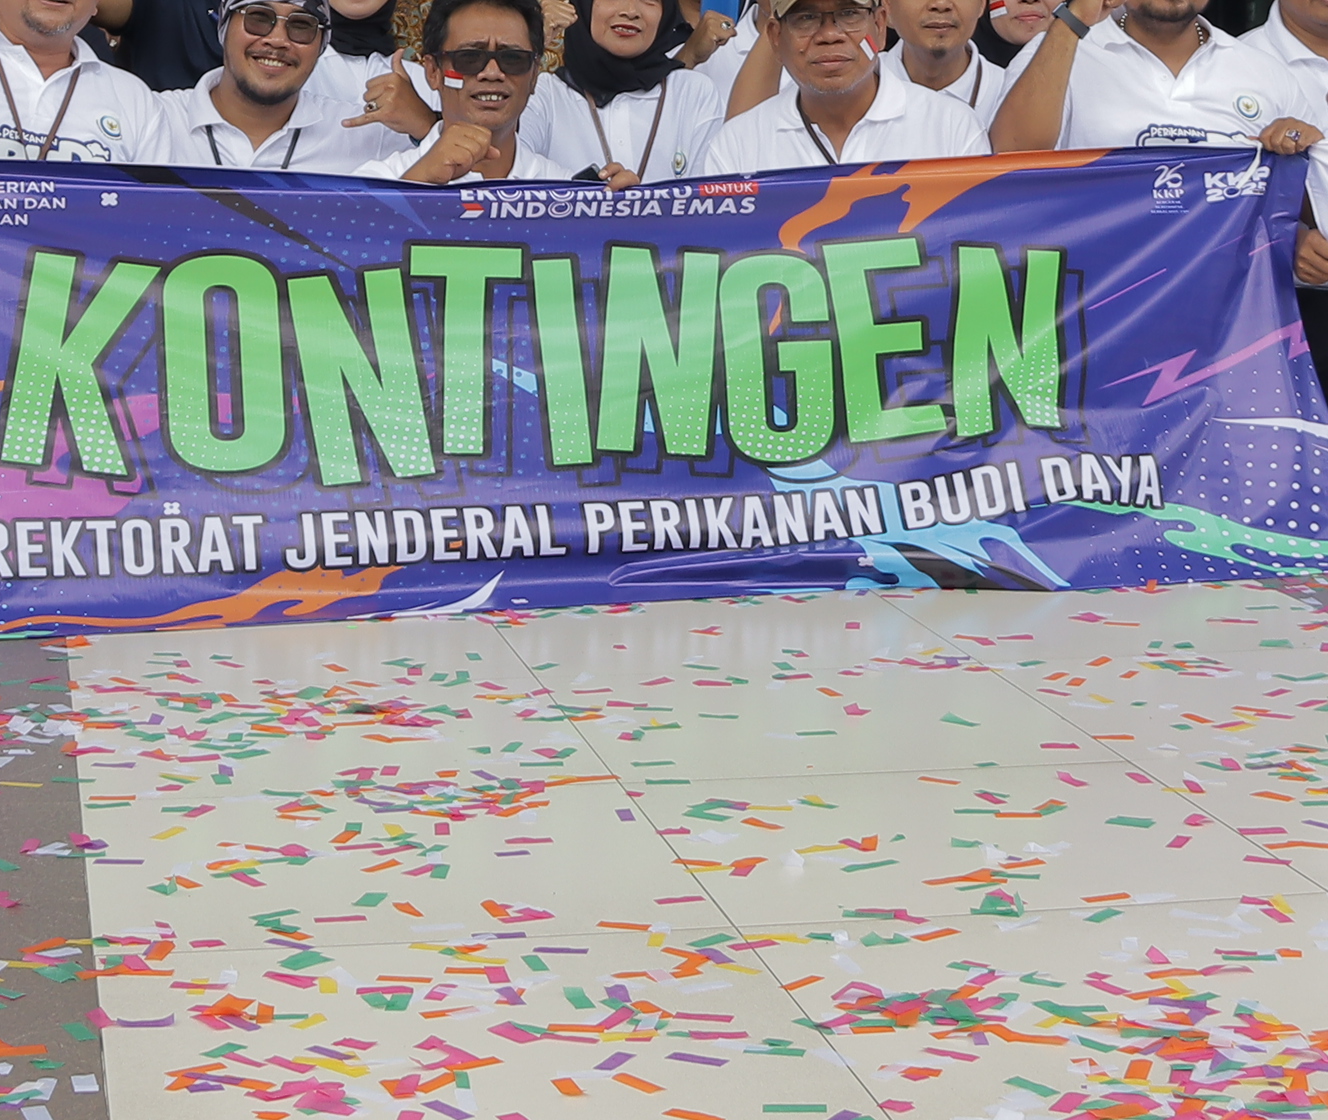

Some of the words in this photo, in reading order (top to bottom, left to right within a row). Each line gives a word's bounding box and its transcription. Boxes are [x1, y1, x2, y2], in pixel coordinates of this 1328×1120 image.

[703, 182, 754, 194] UNTUK
[1152, 189, 1184, 199] KKP
[24, 196, 66, 210] DAN
[490, 200, 663, 218] INDONESIA
[671, 197, 757, 216] EMAS
[0, 236, 1062, 488] KONTINGEN
[285, 504, 567, 570] JENDERAL
[587, 487, 876, 554] PERIKANAN
[900, 460, 1024, 527] BUDI
[1043, 452, 1164, 508] DAYA
